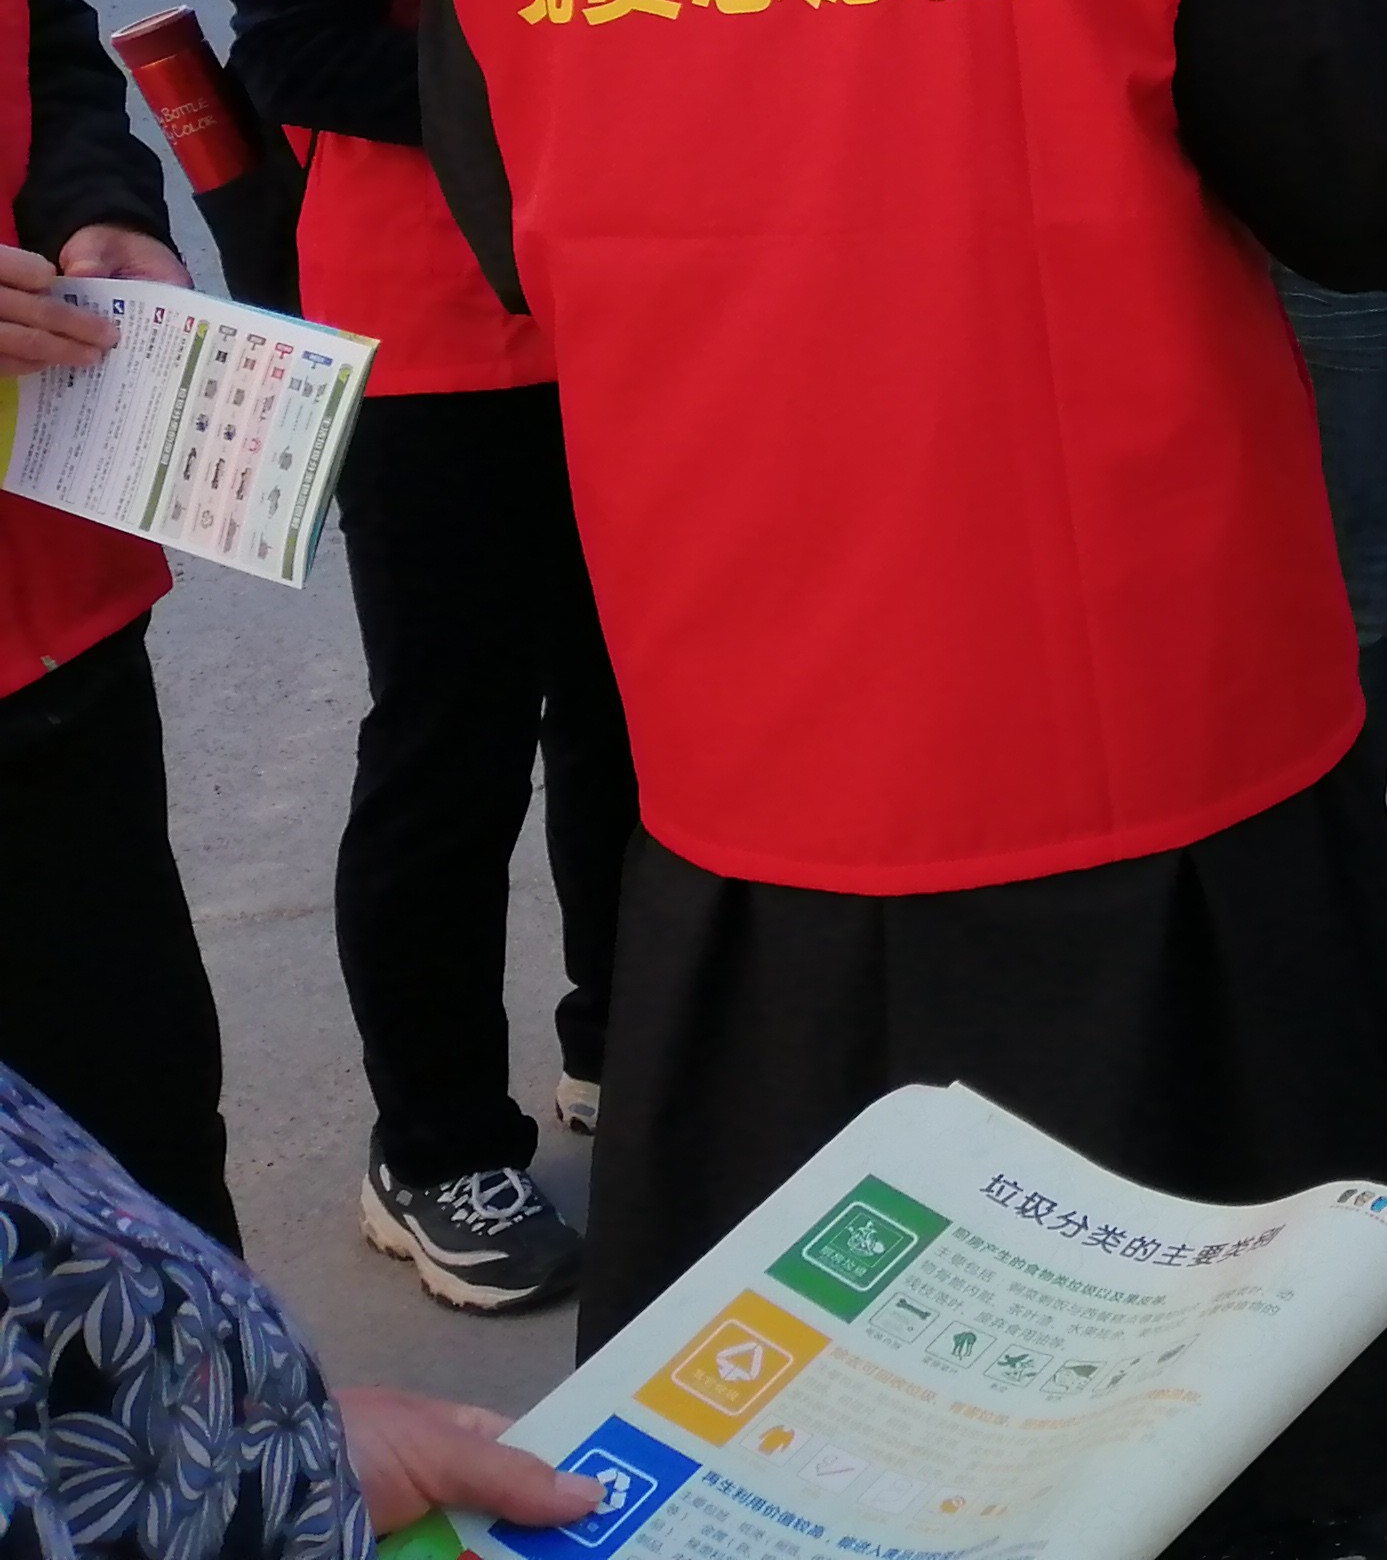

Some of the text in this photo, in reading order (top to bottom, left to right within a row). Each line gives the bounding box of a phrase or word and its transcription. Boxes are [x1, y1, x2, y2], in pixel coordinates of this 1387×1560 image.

[979, 1173, 1286, 1268] 垃圾分类的主要类别
